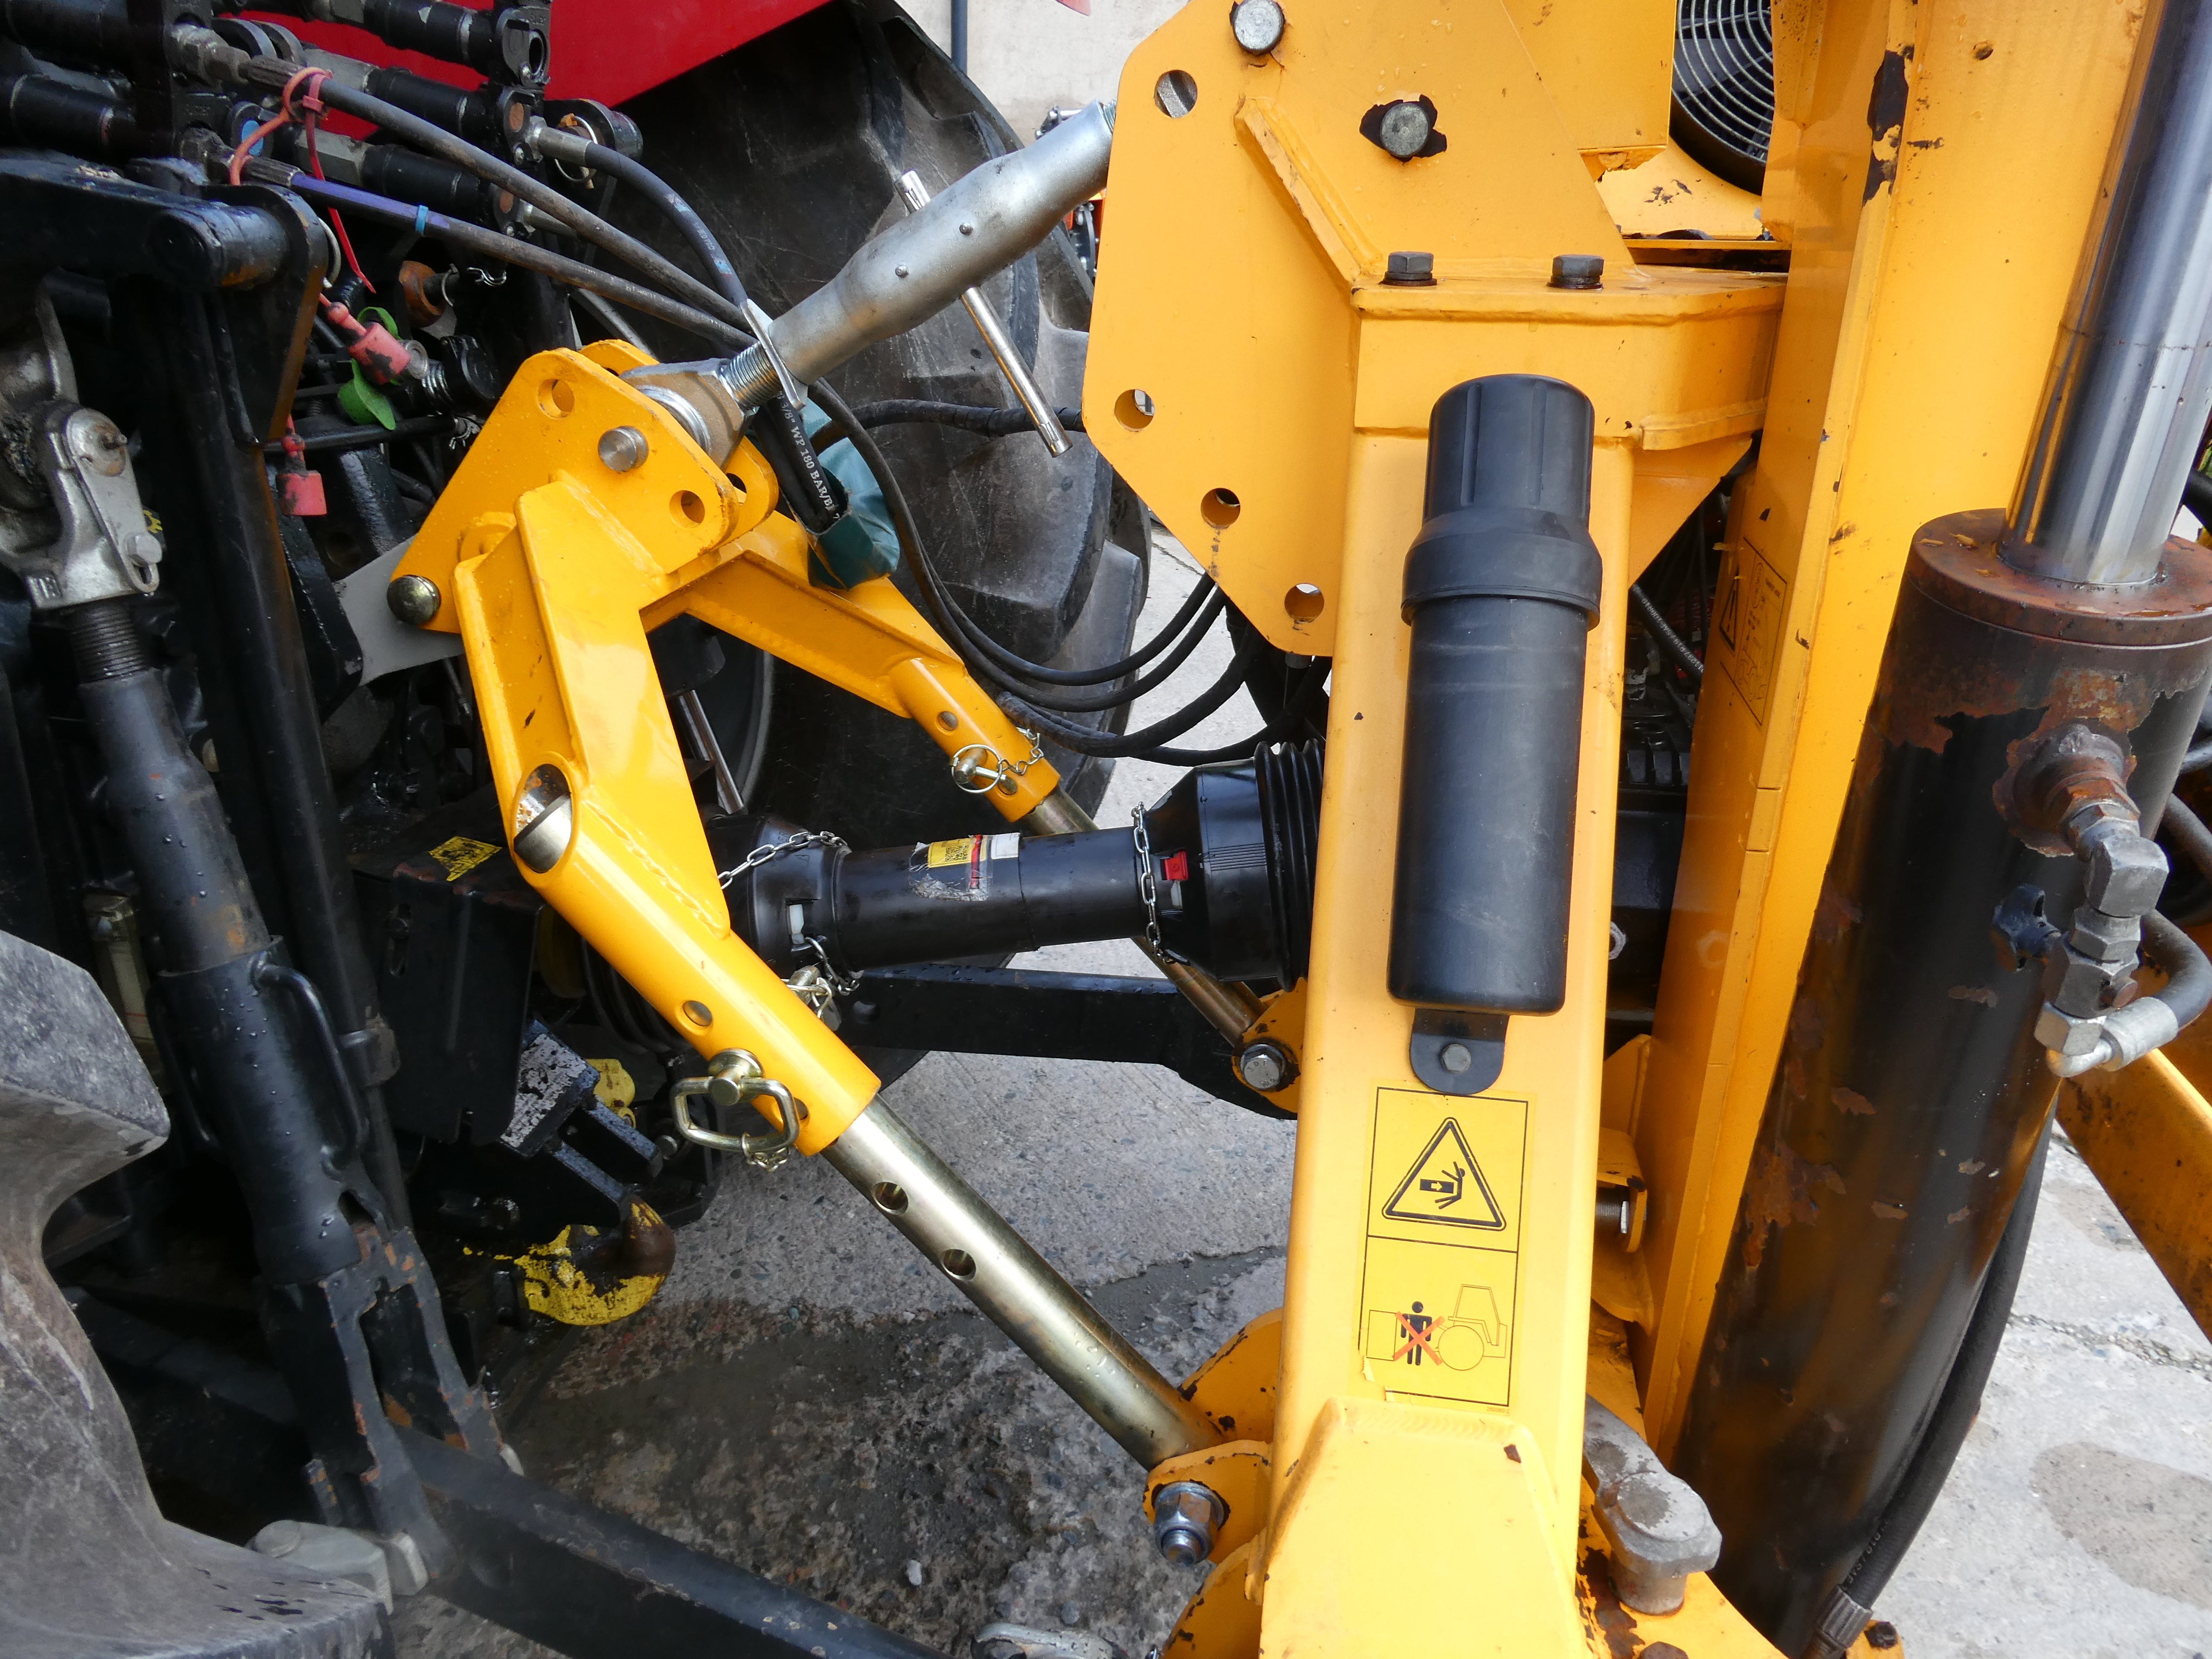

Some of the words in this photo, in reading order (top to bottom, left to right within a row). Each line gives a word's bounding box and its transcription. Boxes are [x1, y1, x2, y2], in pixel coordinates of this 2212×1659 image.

[780, 402, 796, 422] 3/8"
[791, 425, 805, 446] WP
[800, 448, 815, 469] 180
